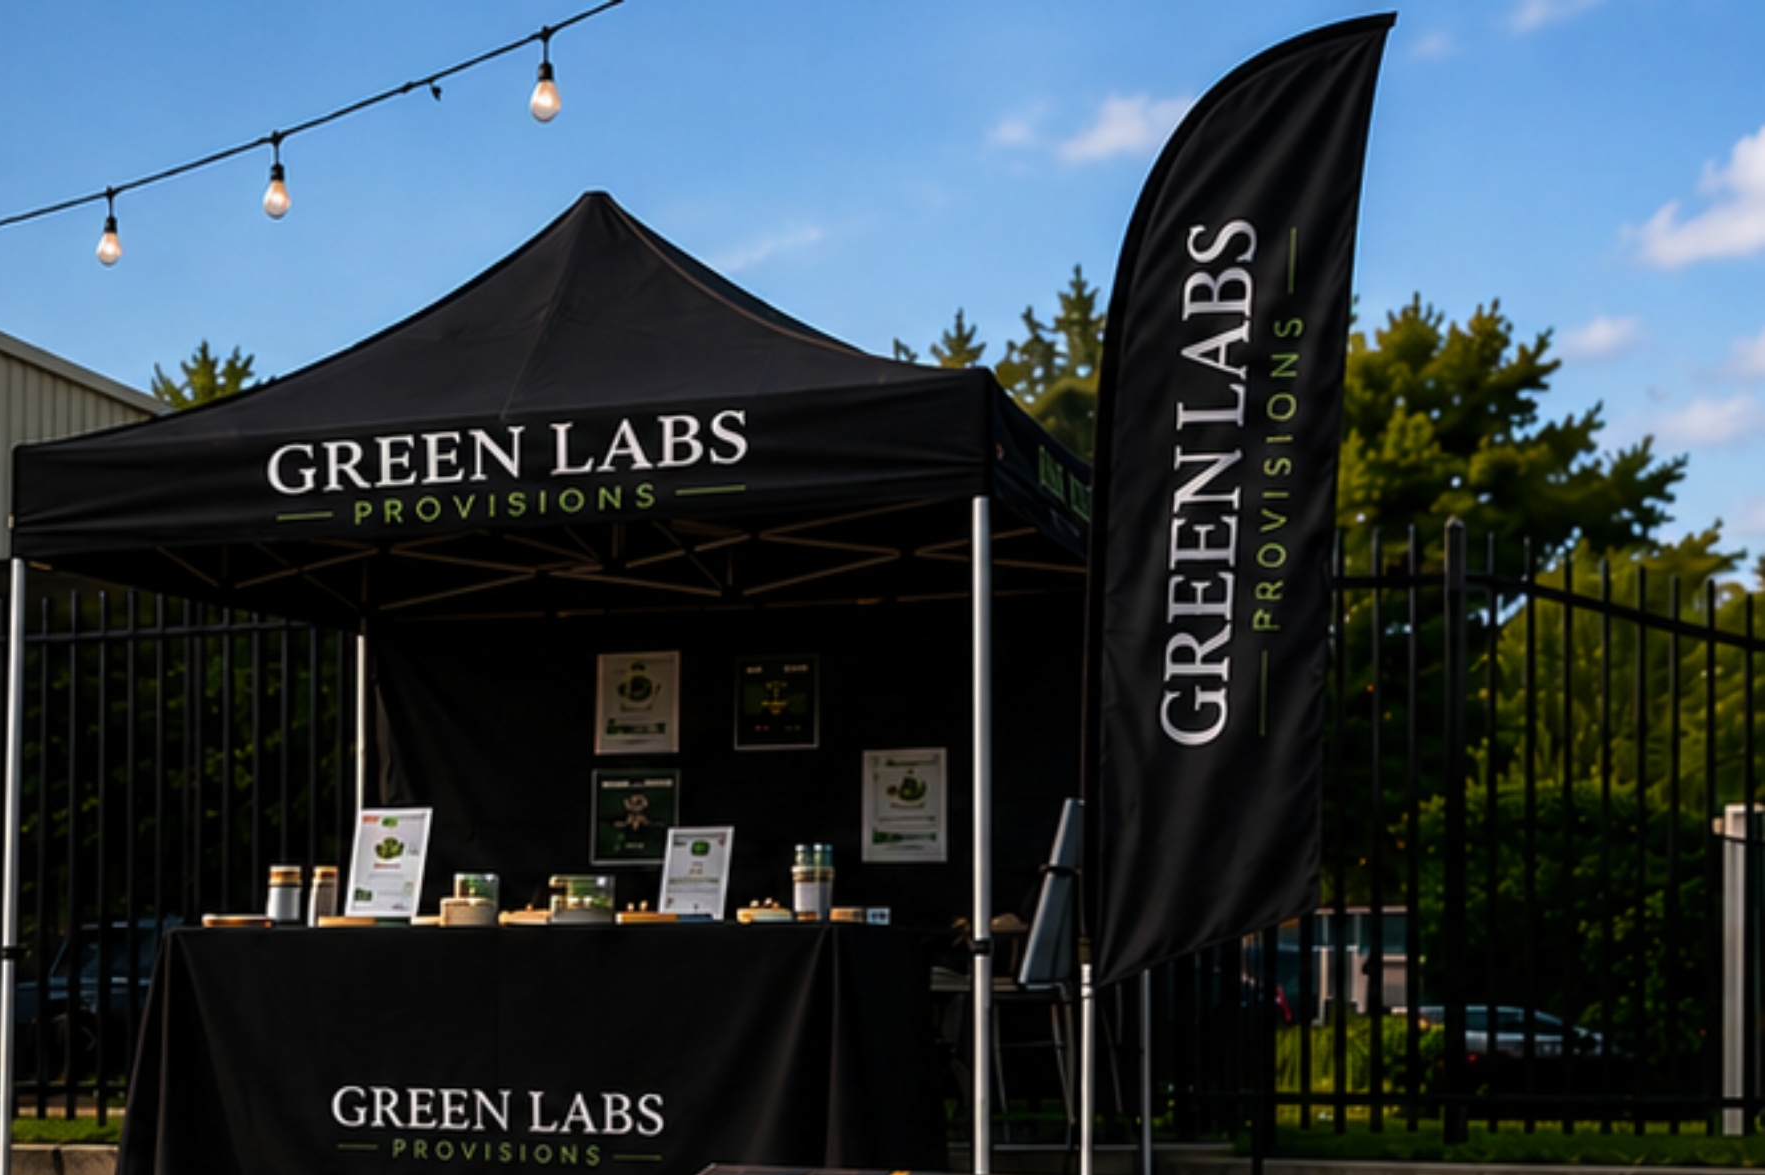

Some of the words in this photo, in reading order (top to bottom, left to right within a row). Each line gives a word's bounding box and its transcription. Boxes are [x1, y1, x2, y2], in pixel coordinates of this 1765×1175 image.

[1176, 219, 1257, 430] LABS
[266, 425, 526, 495] GREEN
[550, 409, 749, 476] LABS
[1252, 317, 1304, 631] PROVISIONS
[353, 483, 656, 525] PROVISIONS
[1160, 446, 1242, 746] GREEN
[330, 1085, 512, 1131] GREEN
[528, 1089, 665, 1136] LABS
[391, 1138, 601, 1166] PROVISIONS
